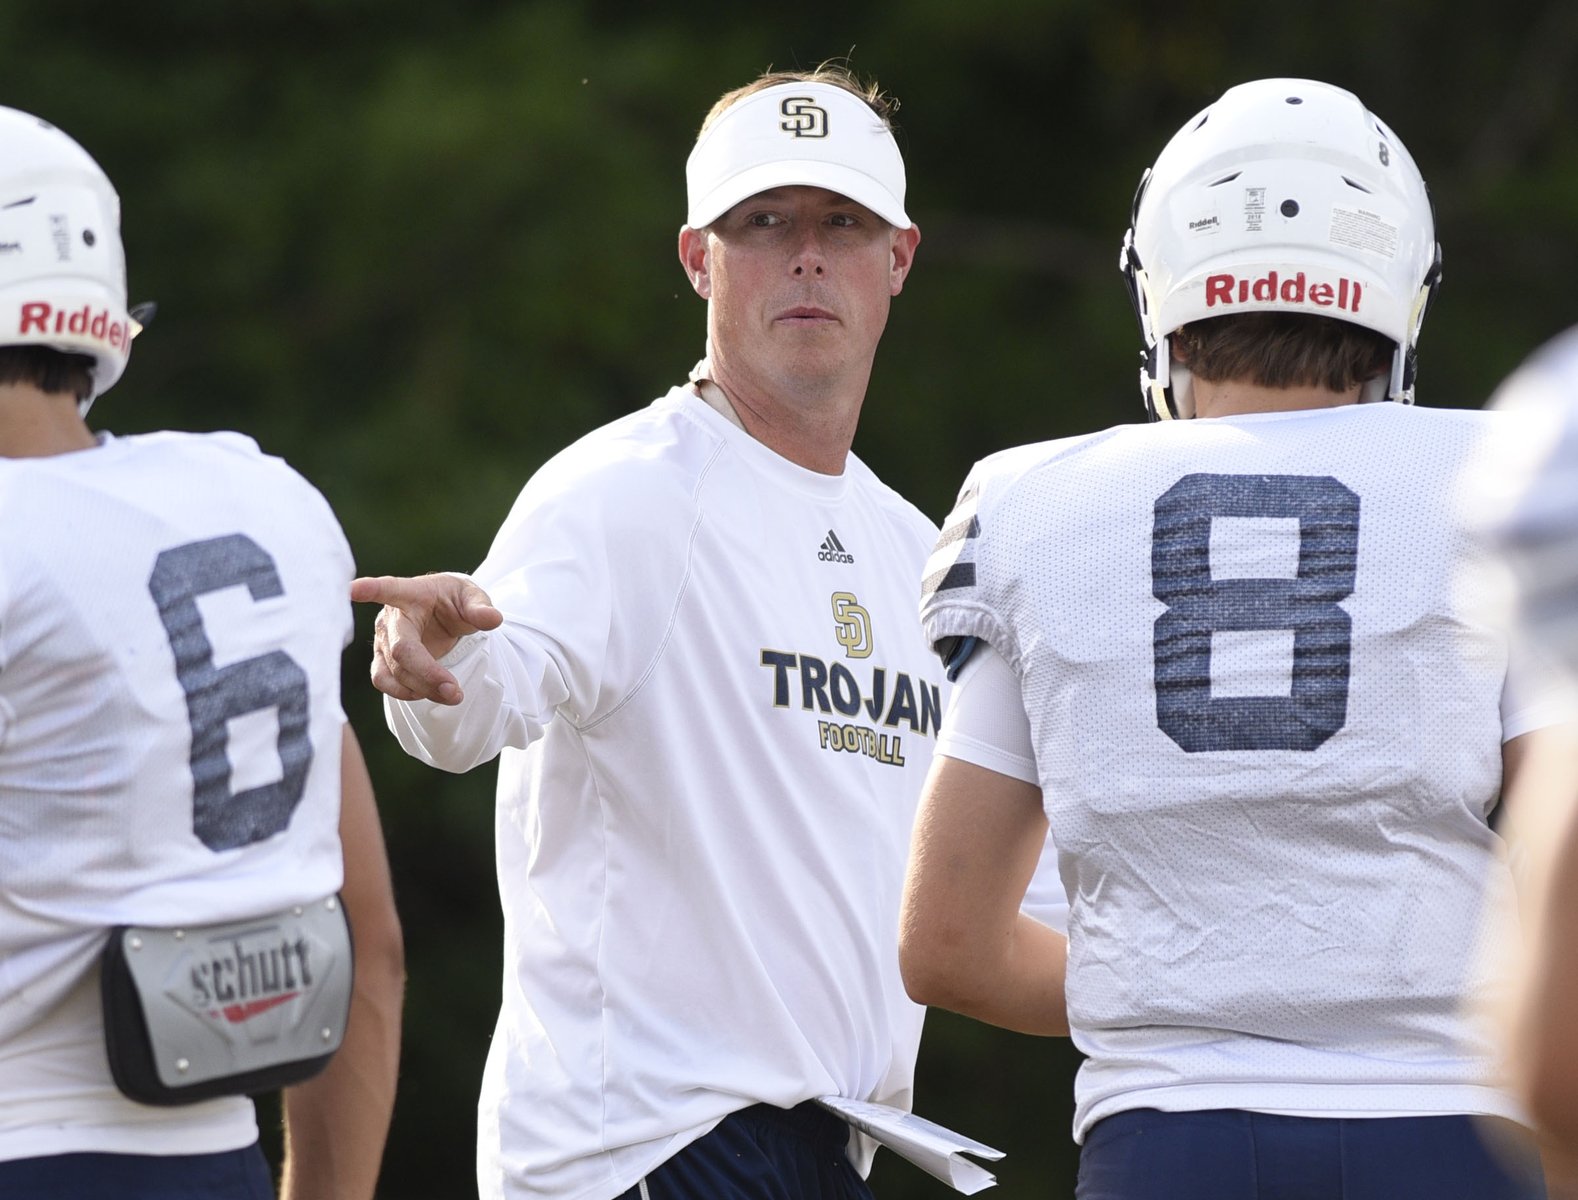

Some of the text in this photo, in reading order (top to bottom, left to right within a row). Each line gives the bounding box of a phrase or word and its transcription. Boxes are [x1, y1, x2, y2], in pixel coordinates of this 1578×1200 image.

[1378, 141, 1390, 167] 8
[1188, 215, 1219, 230] Riddell
[1205, 270, 1362, 313] Riddell
[817, 549, 855, 564] adidas
[1151, 472, 1361, 753] 8
[148, 532, 314, 853] 6
[759, 648, 942, 741] TROJAN
[817, 719, 906, 767] FOOTBLL
[190, 936, 313, 1009] schutt
